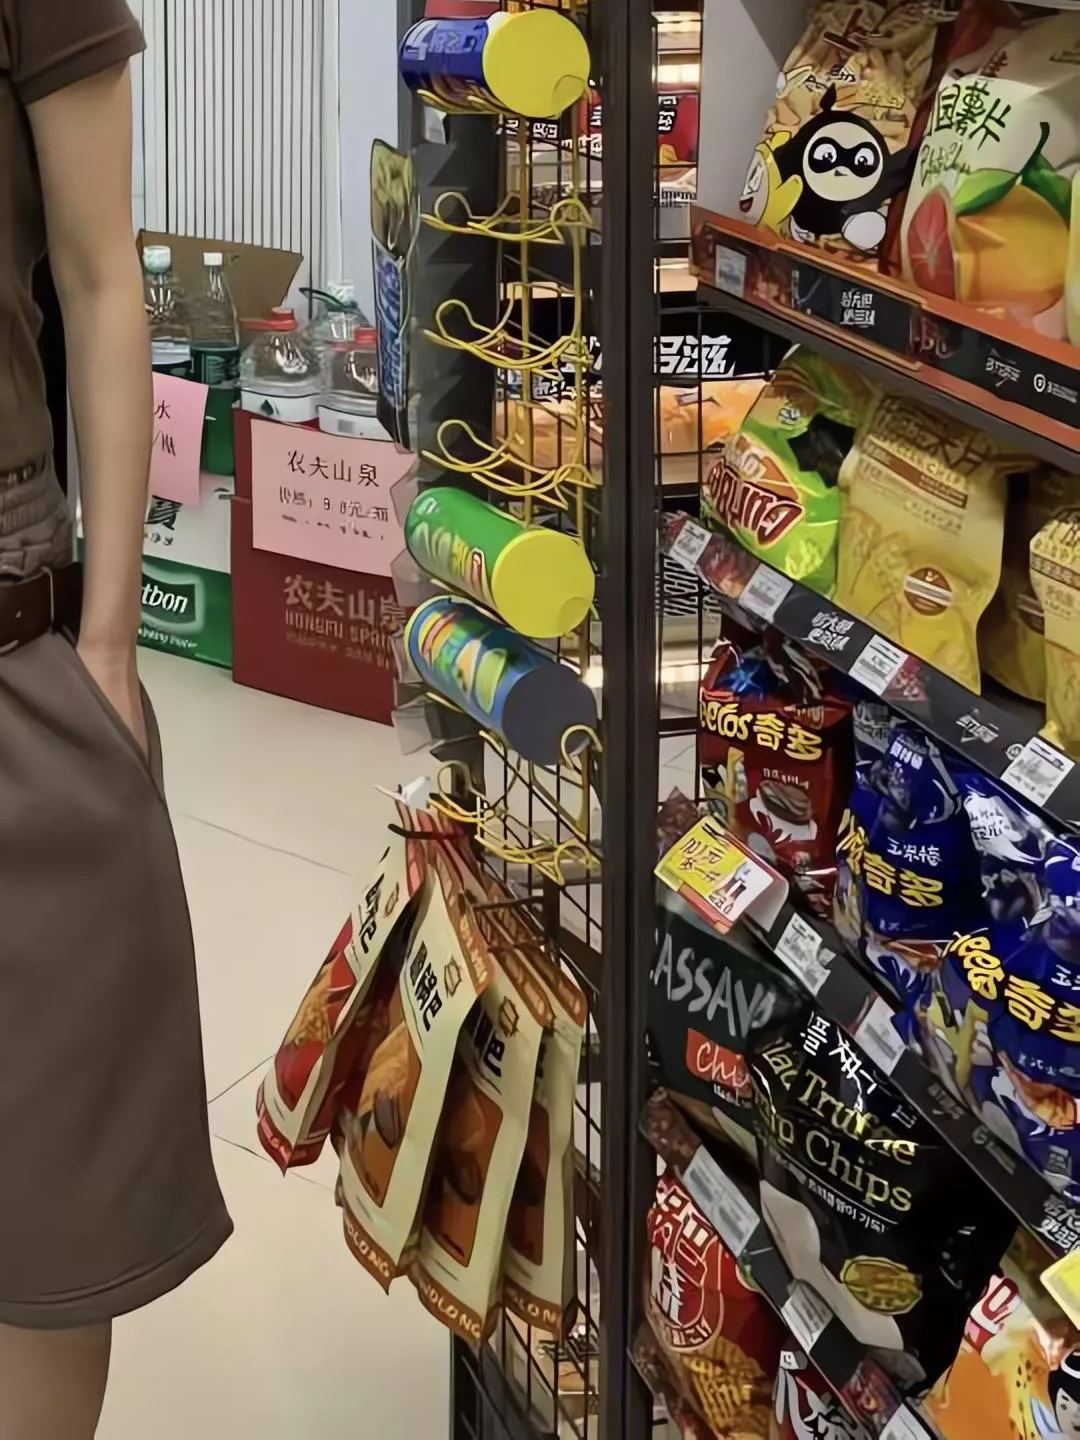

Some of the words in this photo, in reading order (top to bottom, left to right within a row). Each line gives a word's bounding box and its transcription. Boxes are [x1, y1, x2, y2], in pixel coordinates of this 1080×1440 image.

[287, 449, 380, 488] 农夫山泉
[141, 582, 188, 614] tbon
[805, 1129, 913, 1212] Chips
